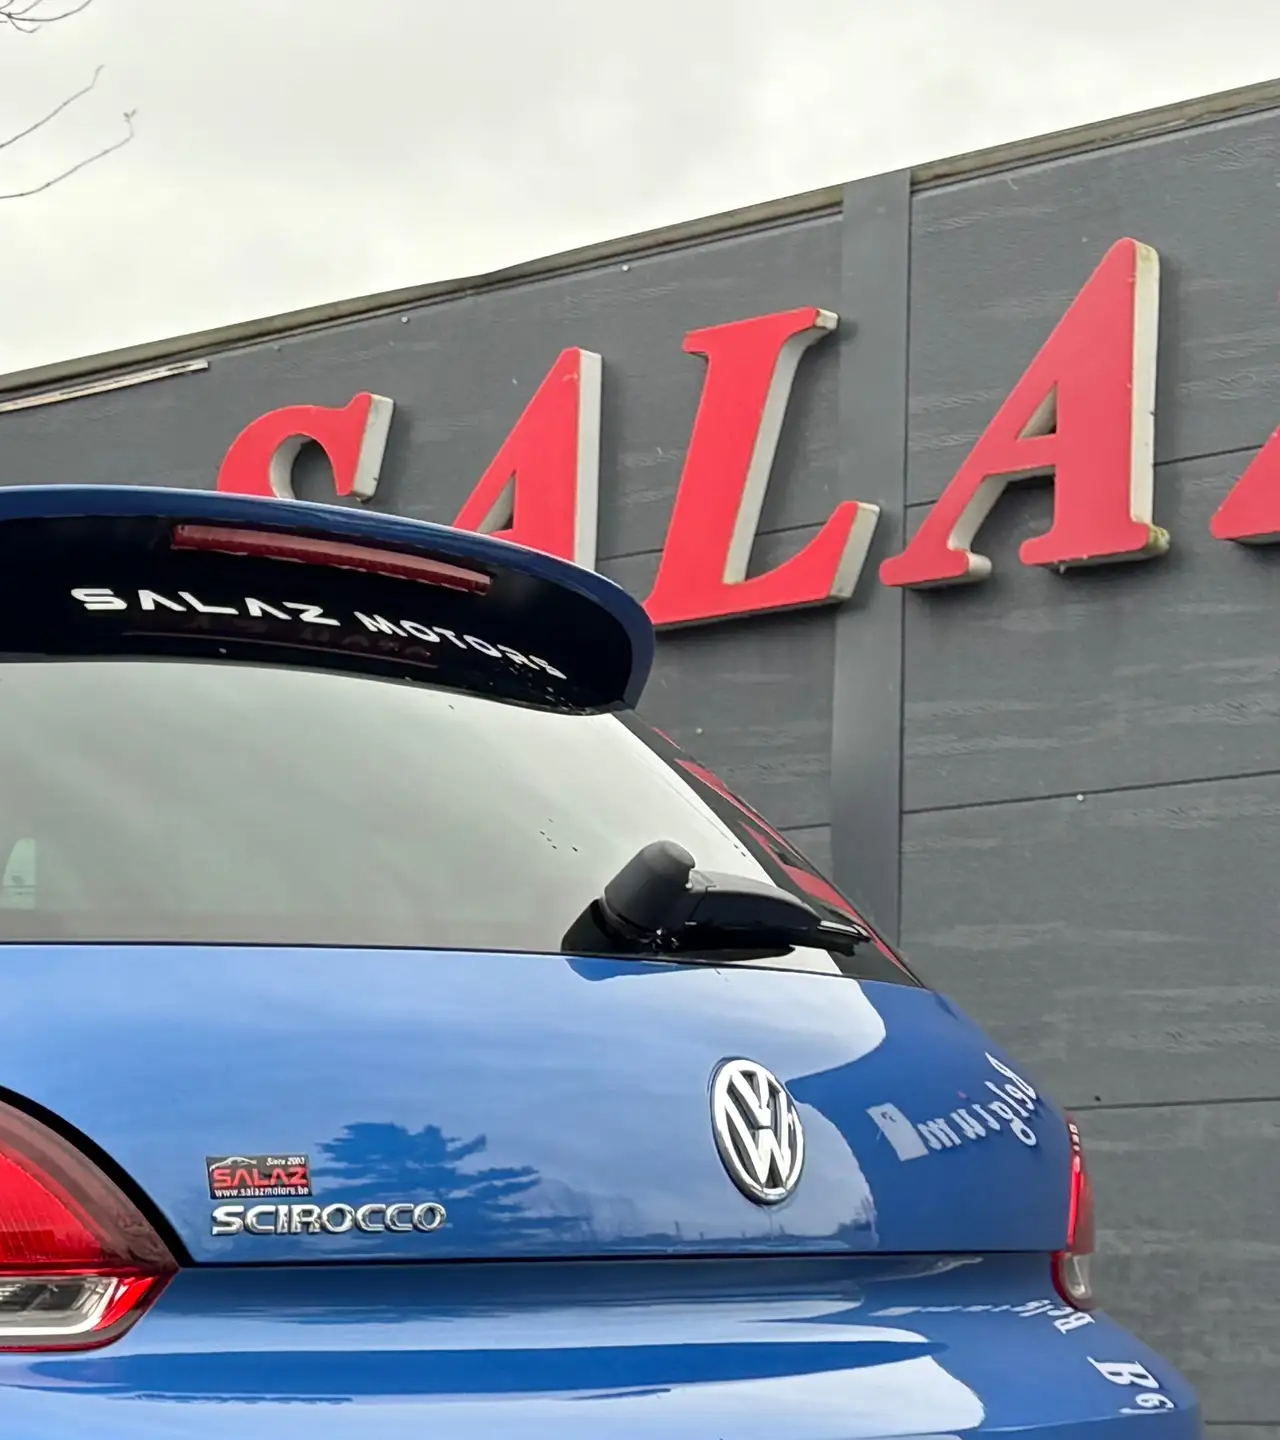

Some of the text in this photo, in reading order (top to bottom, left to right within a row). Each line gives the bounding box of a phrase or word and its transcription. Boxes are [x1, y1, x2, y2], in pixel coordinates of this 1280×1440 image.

[217, 237, 1280, 632] ALA
[70, 587, 341, 627] SALAZ
[354, 611, 568, 681] MOTORS
[212, 1166, 308, 1188] SALAZ
[214, 1186, 310, 1198] www.salazmotors.be
[212, 1202, 447, 1236] SCIROCCO
